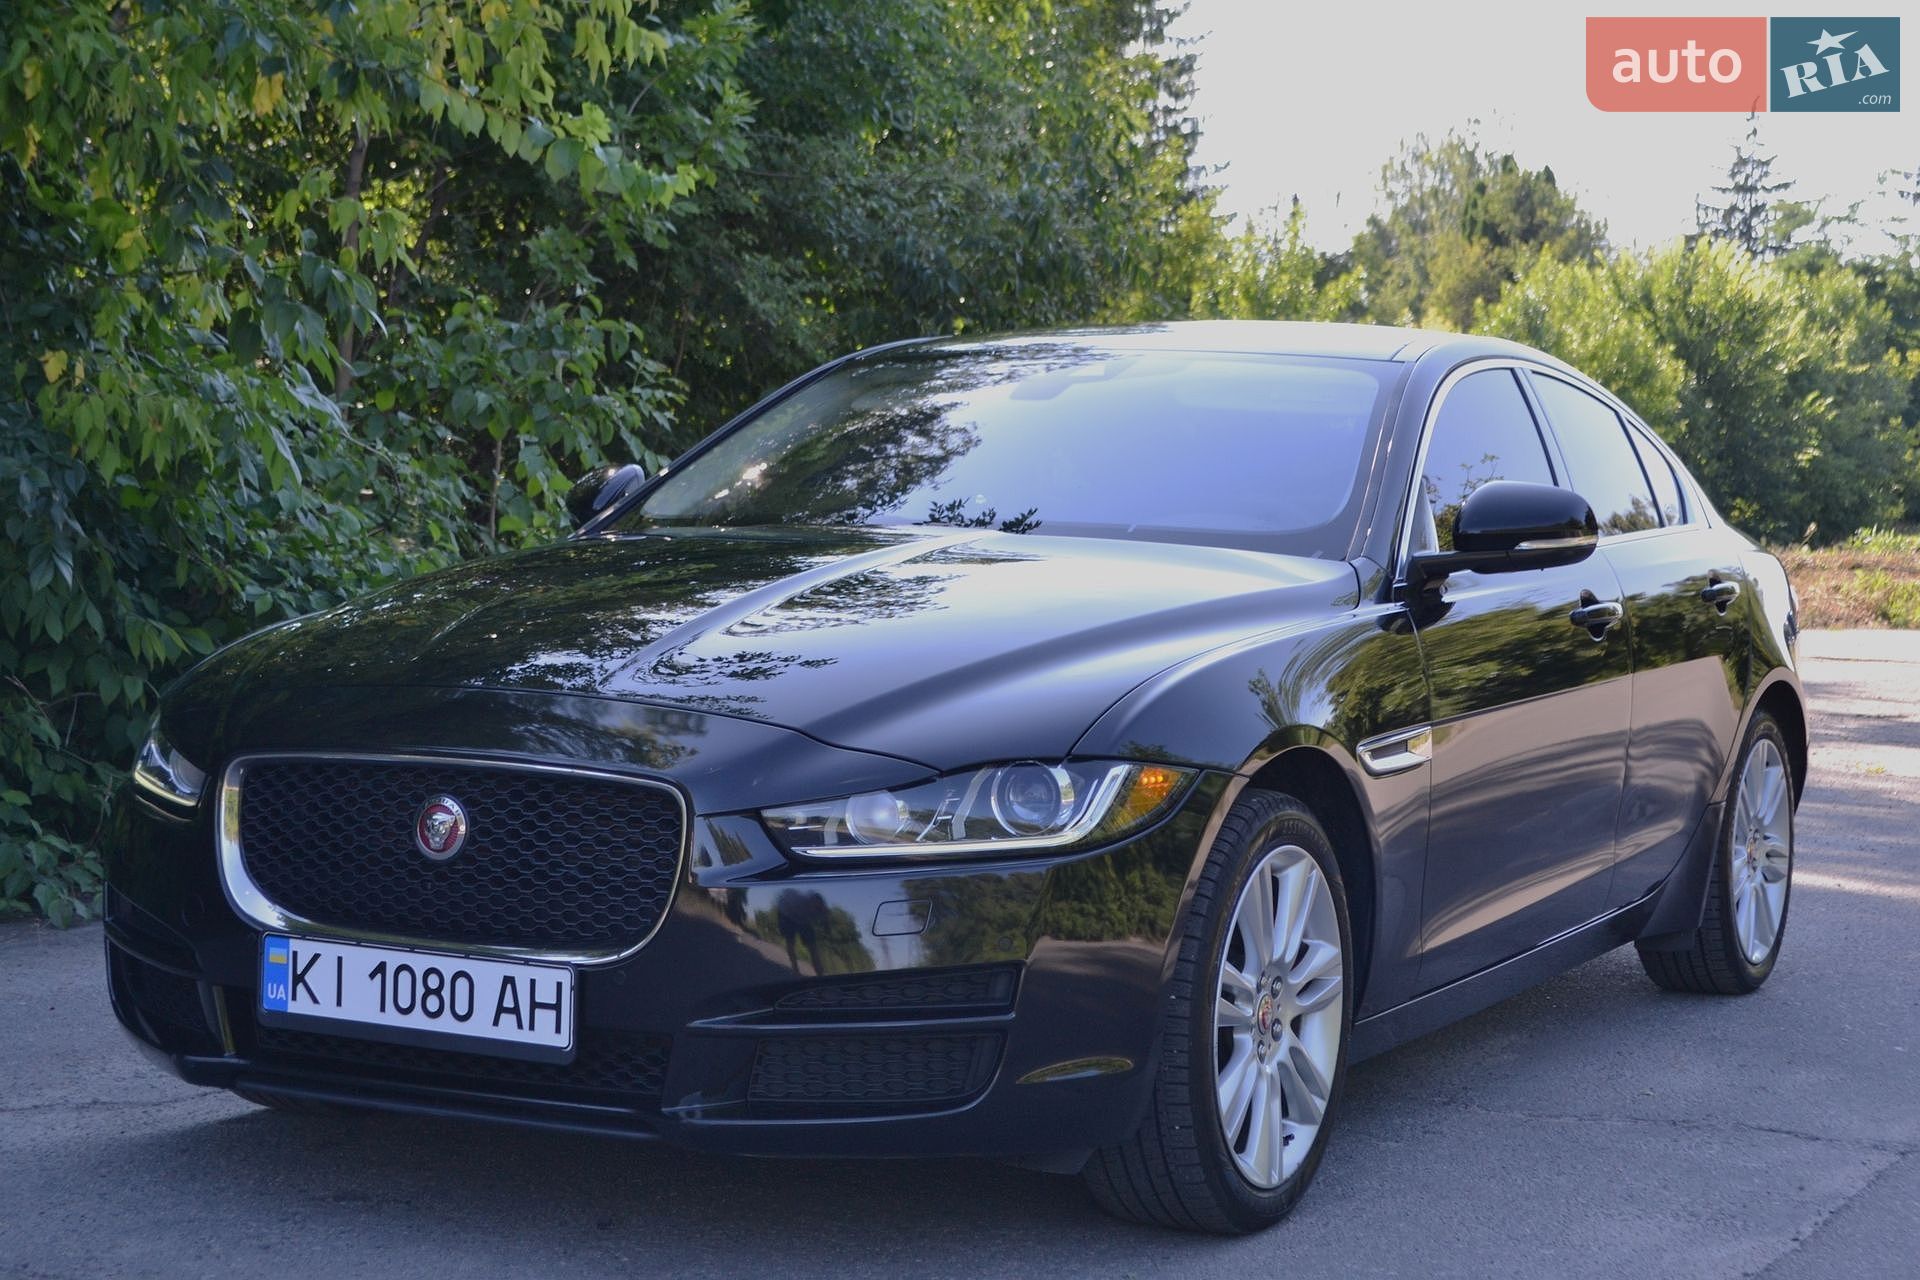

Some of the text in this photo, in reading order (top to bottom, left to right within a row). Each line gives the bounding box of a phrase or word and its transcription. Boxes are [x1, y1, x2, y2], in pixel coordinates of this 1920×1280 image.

[267, 982, 287, 1001] UA
[291, 950, 563, 1034] KI 1080 AH
